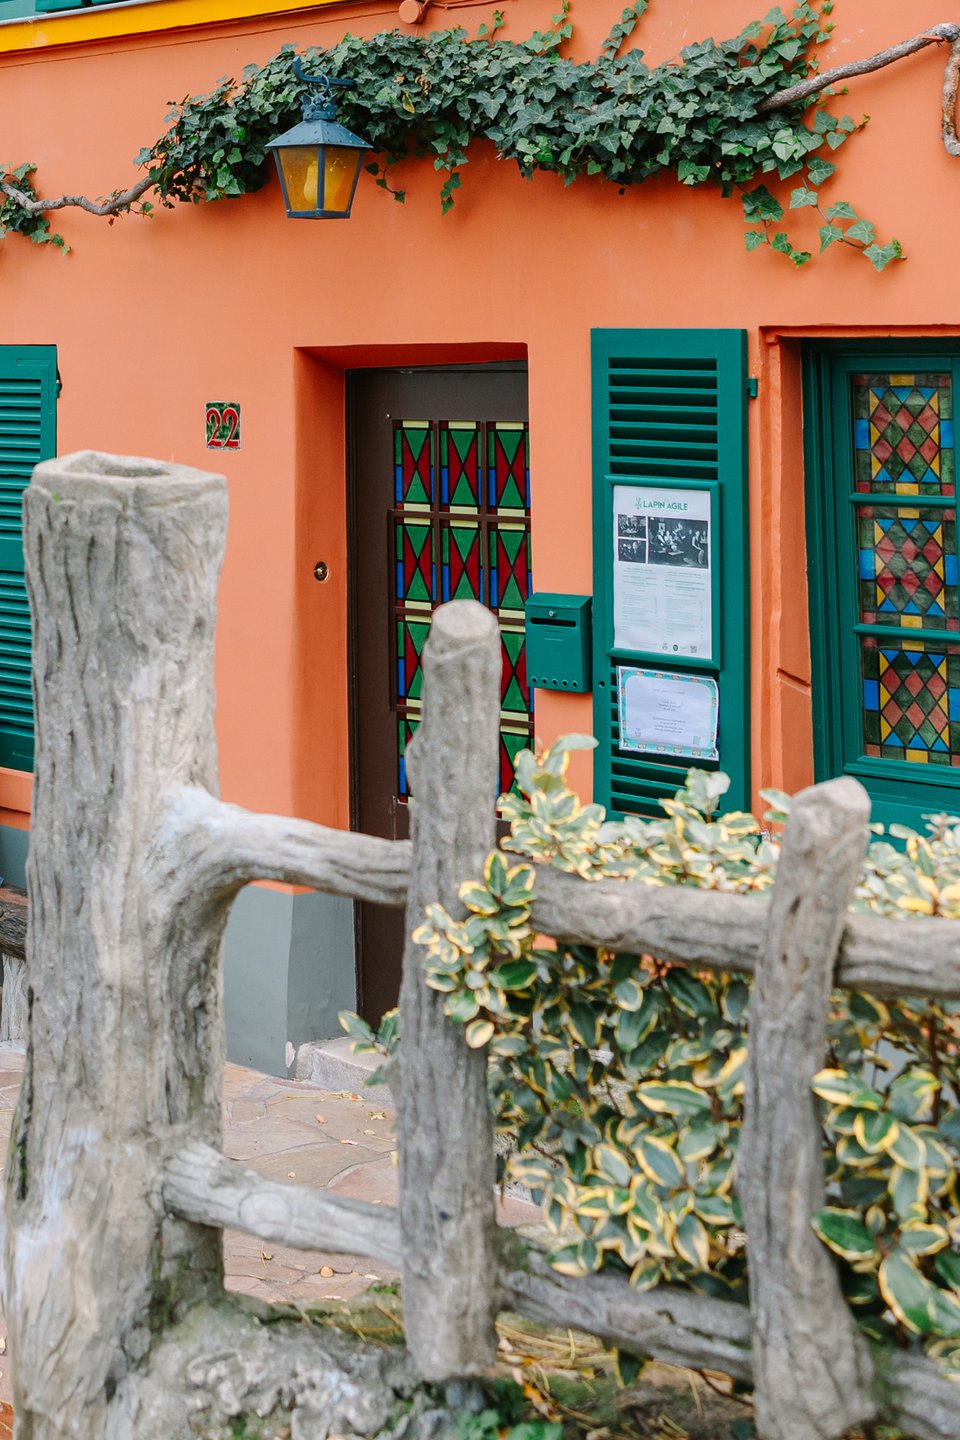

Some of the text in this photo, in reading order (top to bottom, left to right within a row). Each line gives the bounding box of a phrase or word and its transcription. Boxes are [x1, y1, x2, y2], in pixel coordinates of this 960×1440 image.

[206, 407, 239, 447] 22
[643, 500, 688, 511] LAPIN AGILE
